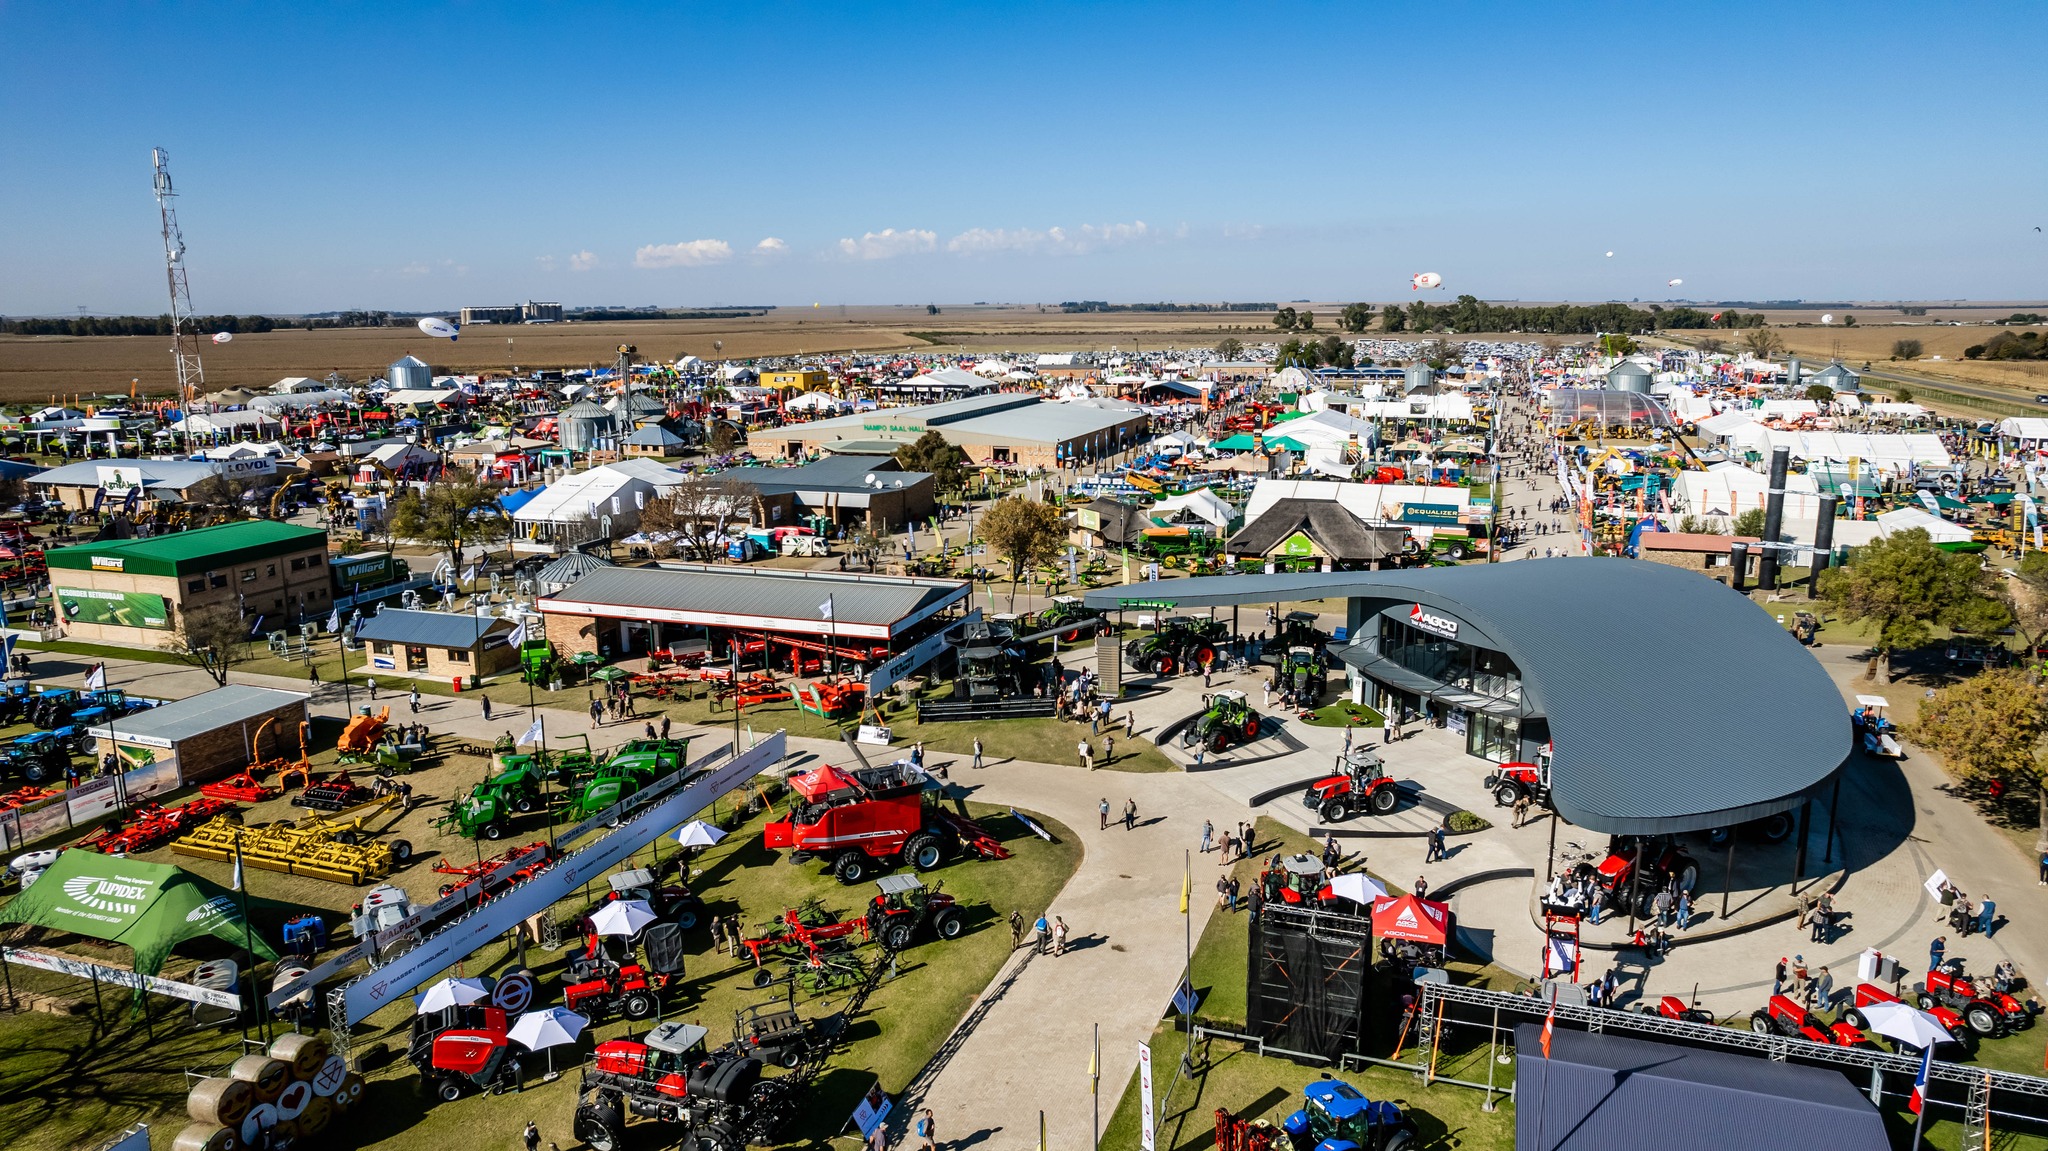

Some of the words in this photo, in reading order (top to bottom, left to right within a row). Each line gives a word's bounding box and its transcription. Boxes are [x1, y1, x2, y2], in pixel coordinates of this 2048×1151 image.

[91, 556, 124, 567] Willard
[348, 560, 385, 576] Willard
[1423, 614, 1458, 632] AGCO
[889, 655, 915, 679] FENDT
[75, 780, 109, 795] TOSCANO
[20, 793, 68, 815] Degelman
[93, 880, 146, 900] JUPIDEX
[386, 915, 422, 940] ALPLER
[474, 924, 489, 935] FARM
[390, 965, 417, 985] MASSEY
[416, 947, 449, 969] FERGUSON
